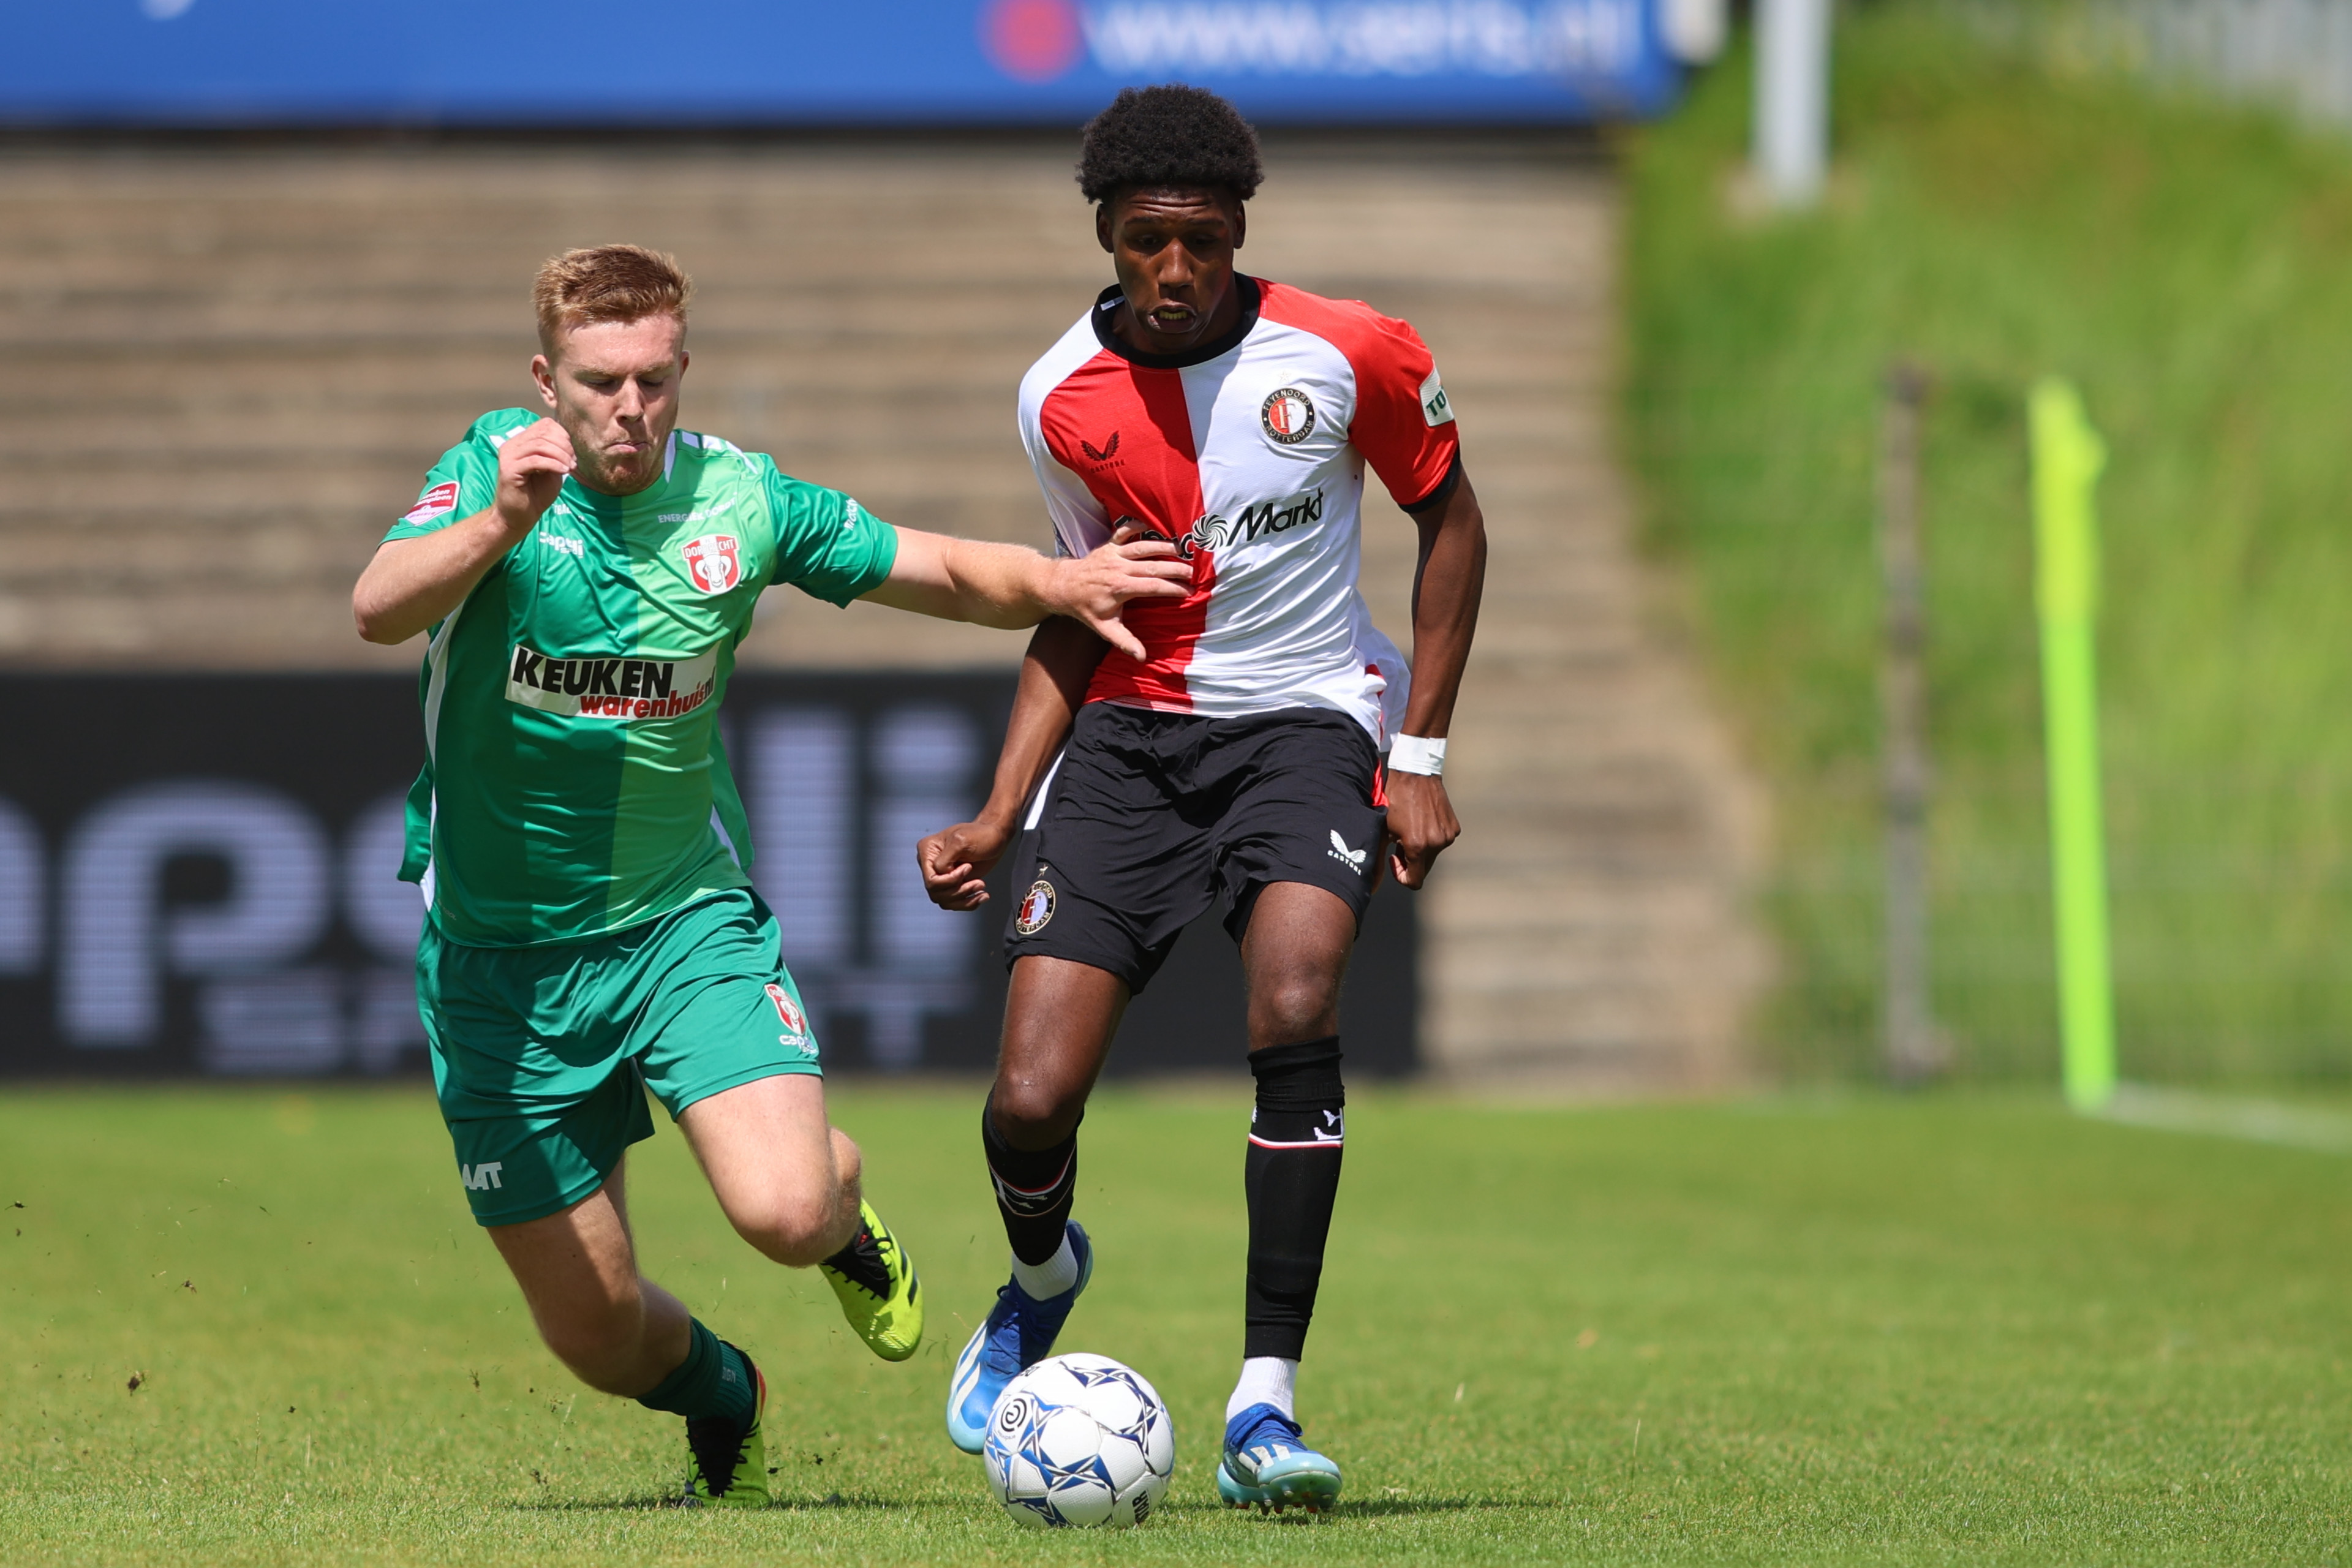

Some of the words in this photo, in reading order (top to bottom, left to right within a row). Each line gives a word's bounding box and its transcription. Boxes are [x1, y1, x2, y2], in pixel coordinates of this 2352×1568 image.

[1263, 389, 1311, 410] FEYENOORD
[1426, 390, 1446, 417] TO
[1266, 420, 1313, 442] ROTTERDAM
[657, 511, 704, 523] ENERGIEK
[1227, 488, 1323, 546] Markt
[684, 539, 735, 557] DORDRECHT
[511, 647, 674, 696] KEUKEN
